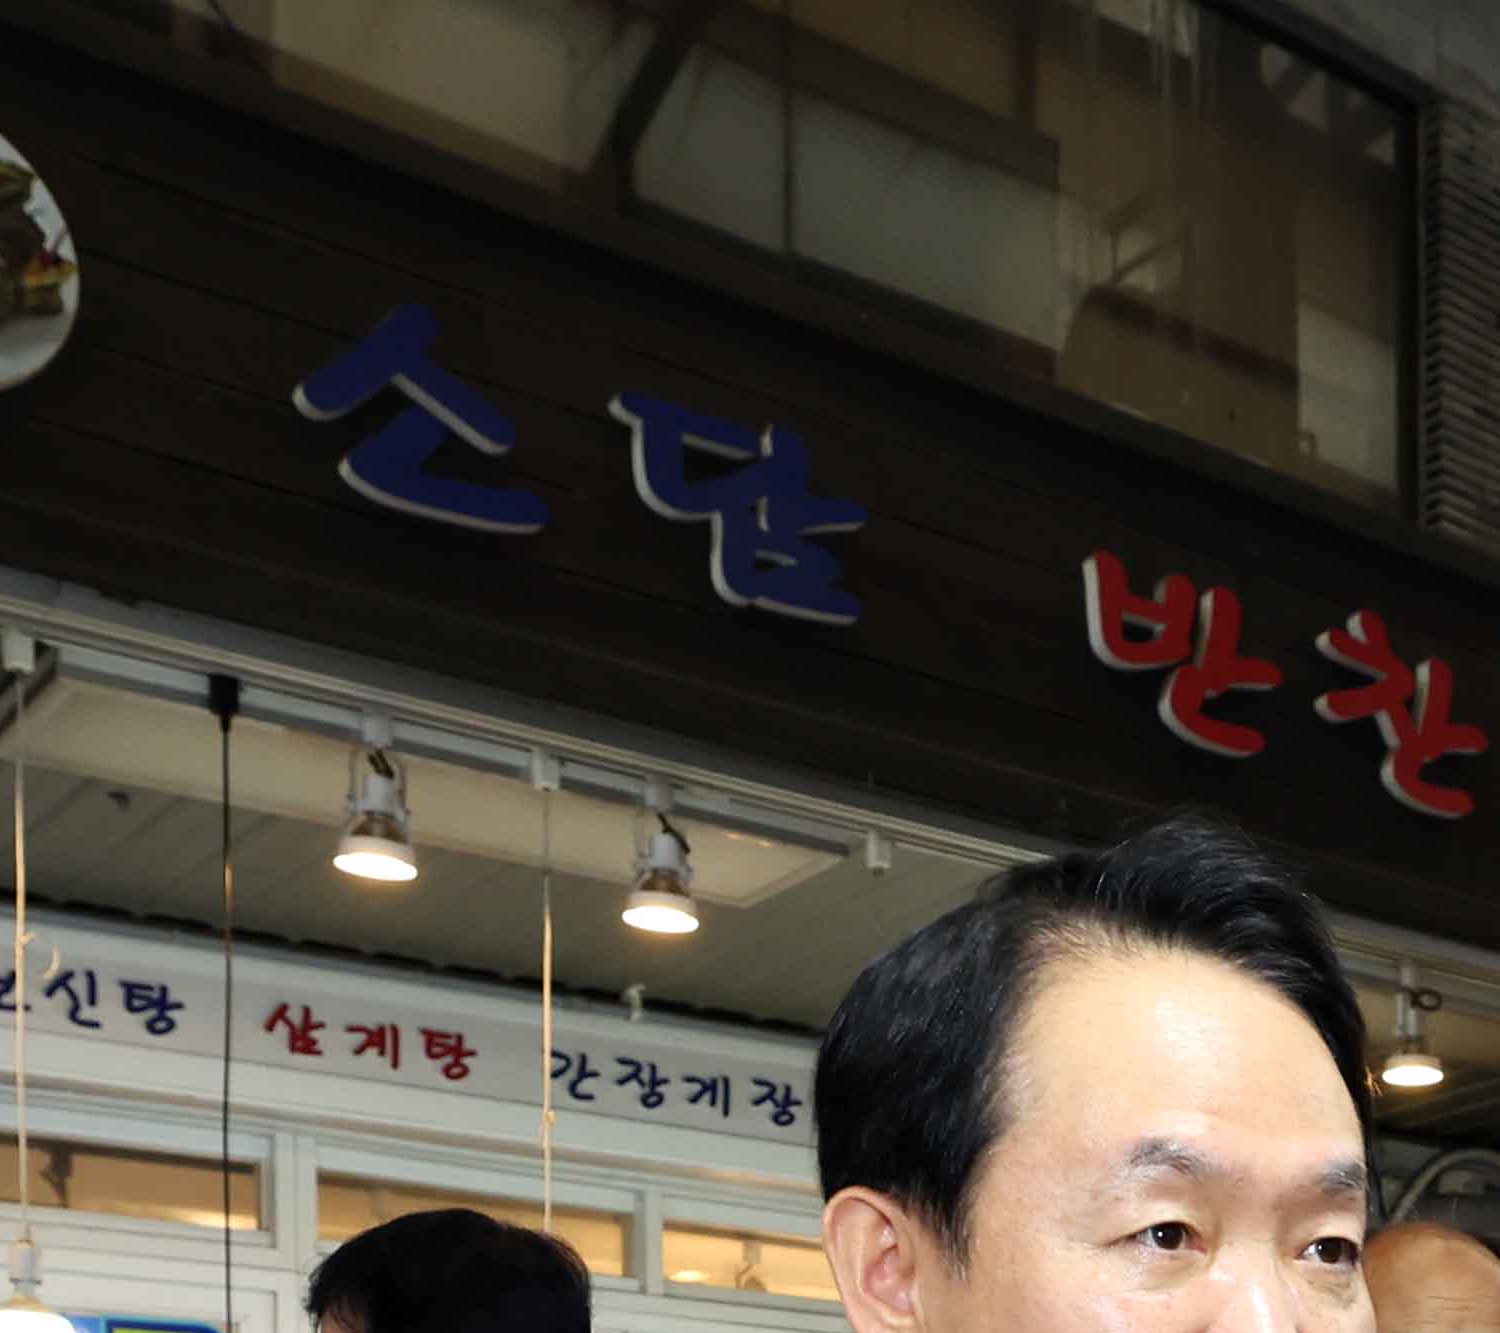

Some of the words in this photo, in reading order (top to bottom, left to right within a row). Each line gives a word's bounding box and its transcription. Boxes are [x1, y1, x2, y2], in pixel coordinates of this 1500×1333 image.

[1081, 550, 1488, 817] 반찬
[264, 1002, 476, 1080] 삼계탕
[551, 1049, 802, 1125] 간장게장
